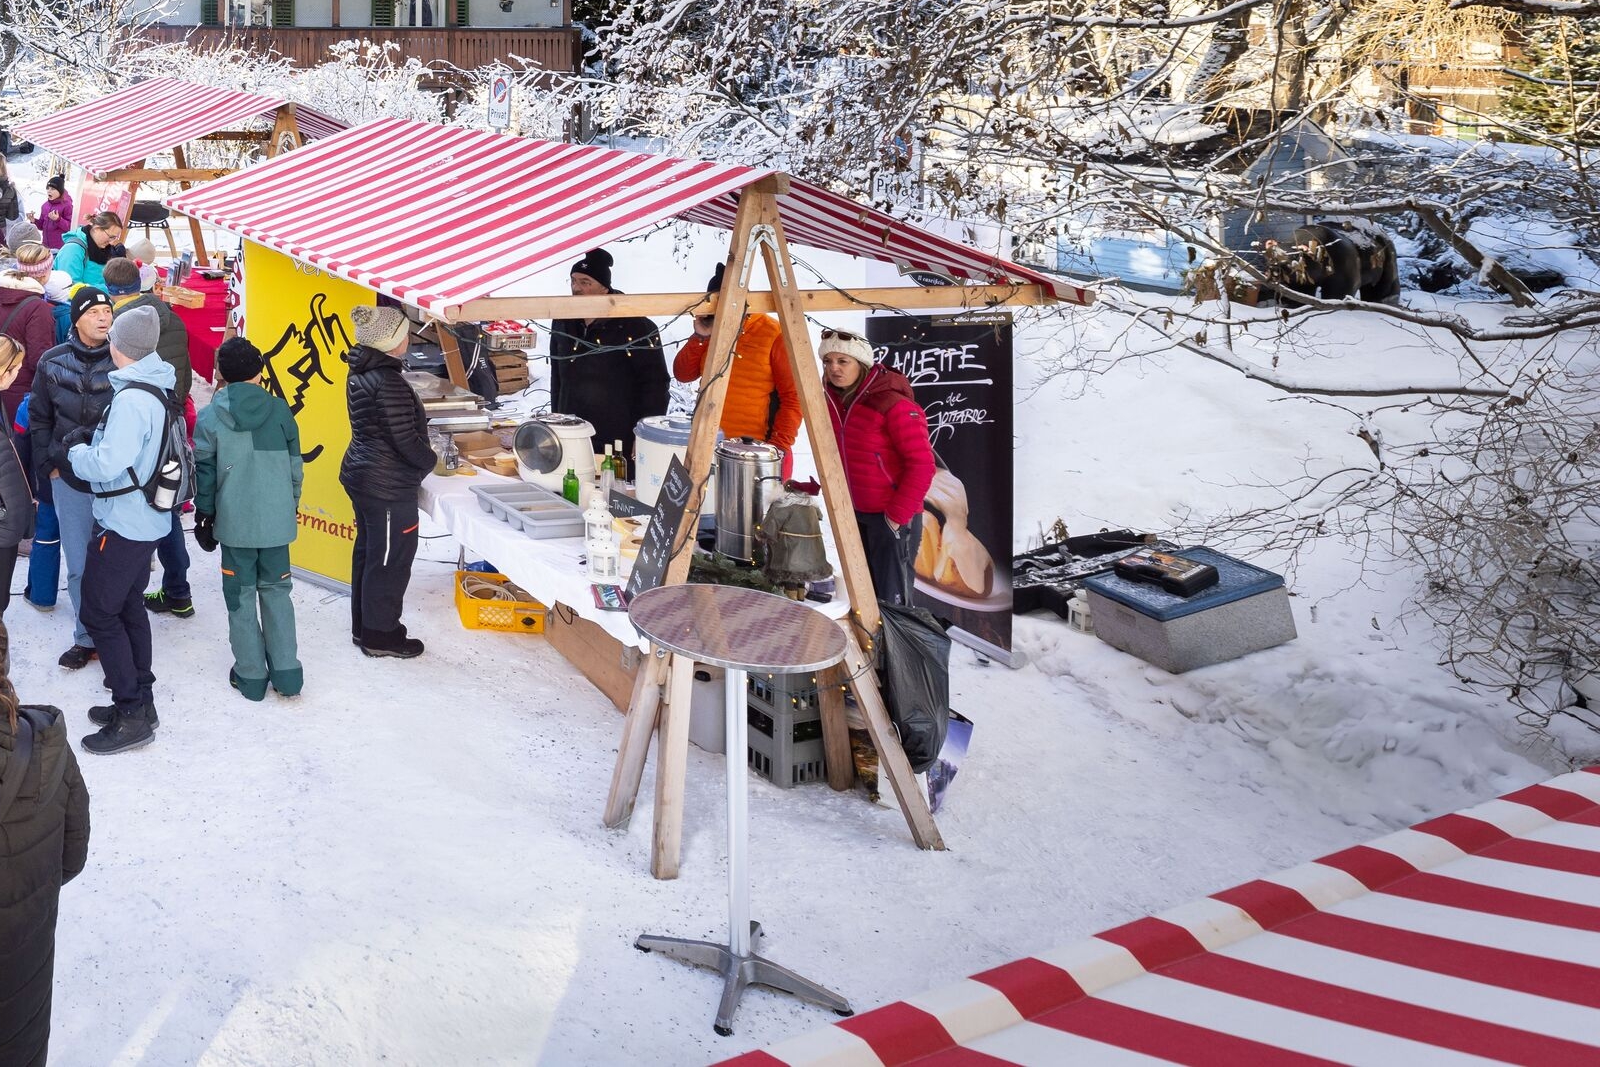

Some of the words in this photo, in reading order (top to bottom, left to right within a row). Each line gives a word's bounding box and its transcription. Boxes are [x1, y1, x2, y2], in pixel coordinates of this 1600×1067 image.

[490, 108, 507, 120] Privat
[877, 178, 915, 198] Priat
[296, 512, 355, 541] ermatt
